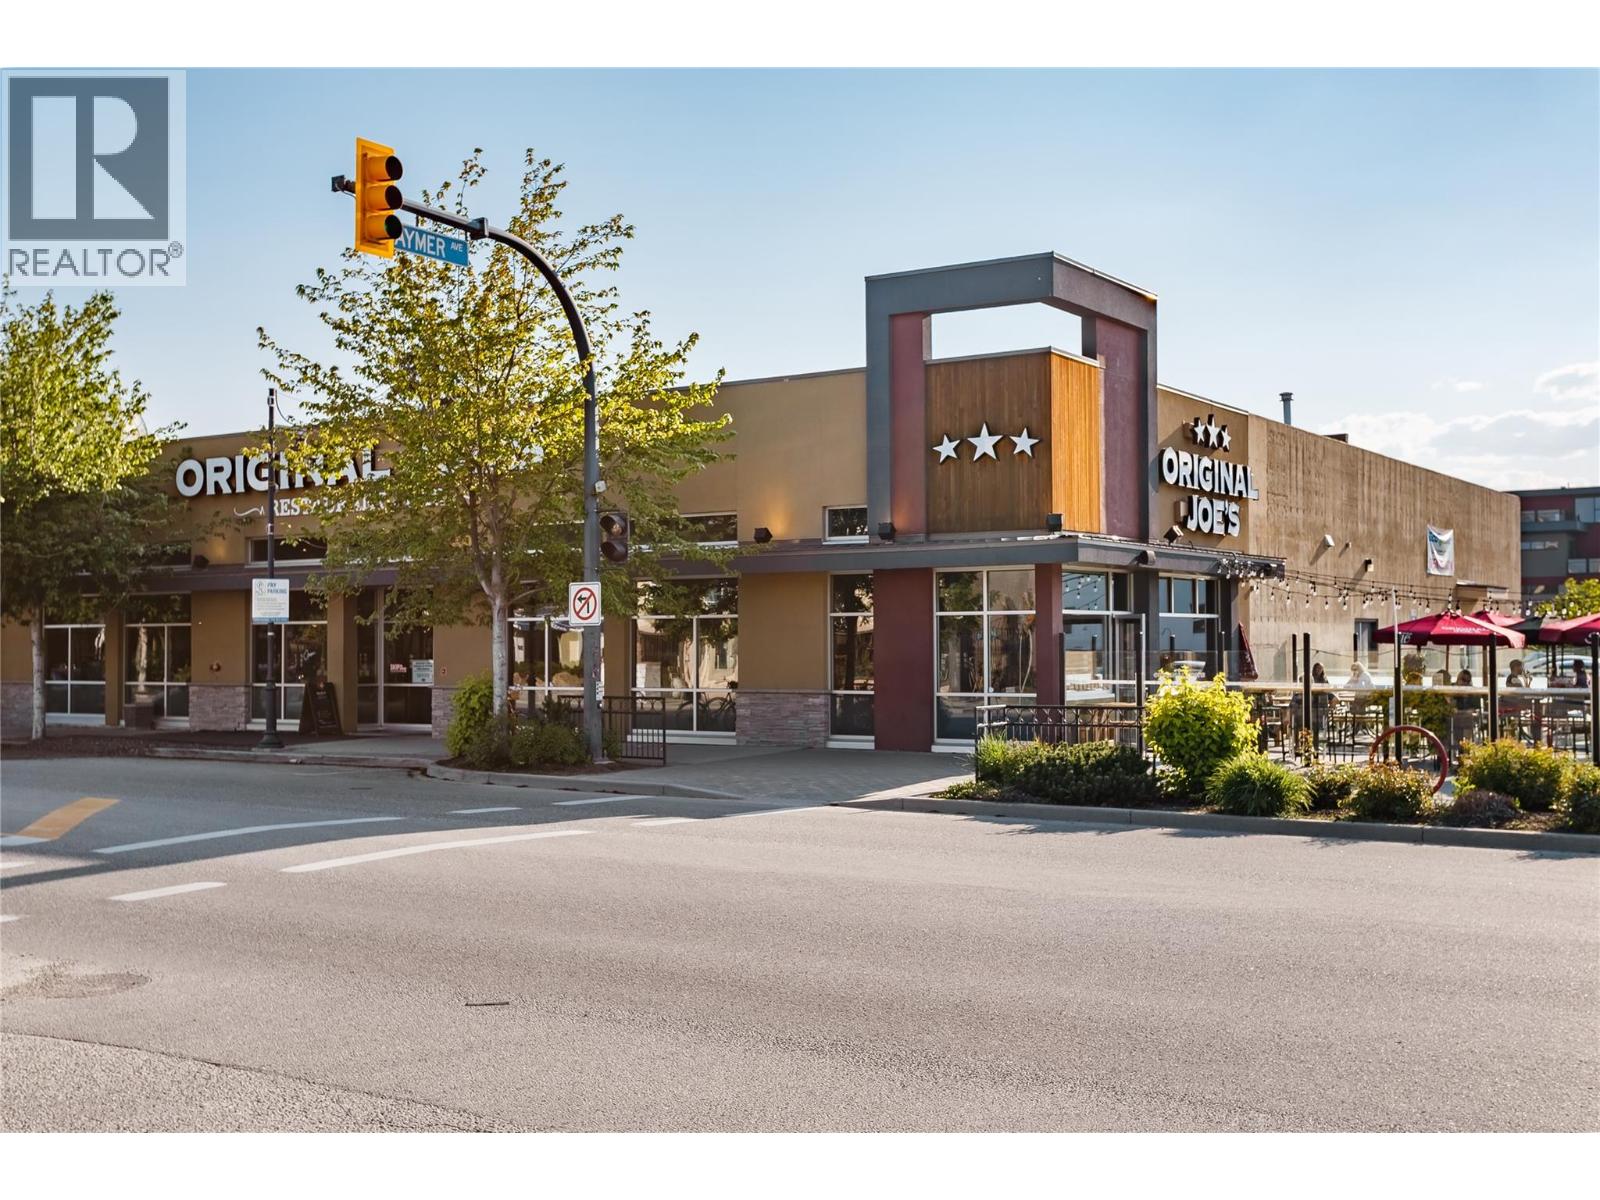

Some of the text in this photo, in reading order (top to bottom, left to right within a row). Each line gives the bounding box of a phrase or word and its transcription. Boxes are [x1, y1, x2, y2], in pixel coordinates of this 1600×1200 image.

[451, 242, 464, 252] AVE
[1161, 446, 1259, 500] ORIGINAL
[1186, 494, 1240, 538] JOE'S
